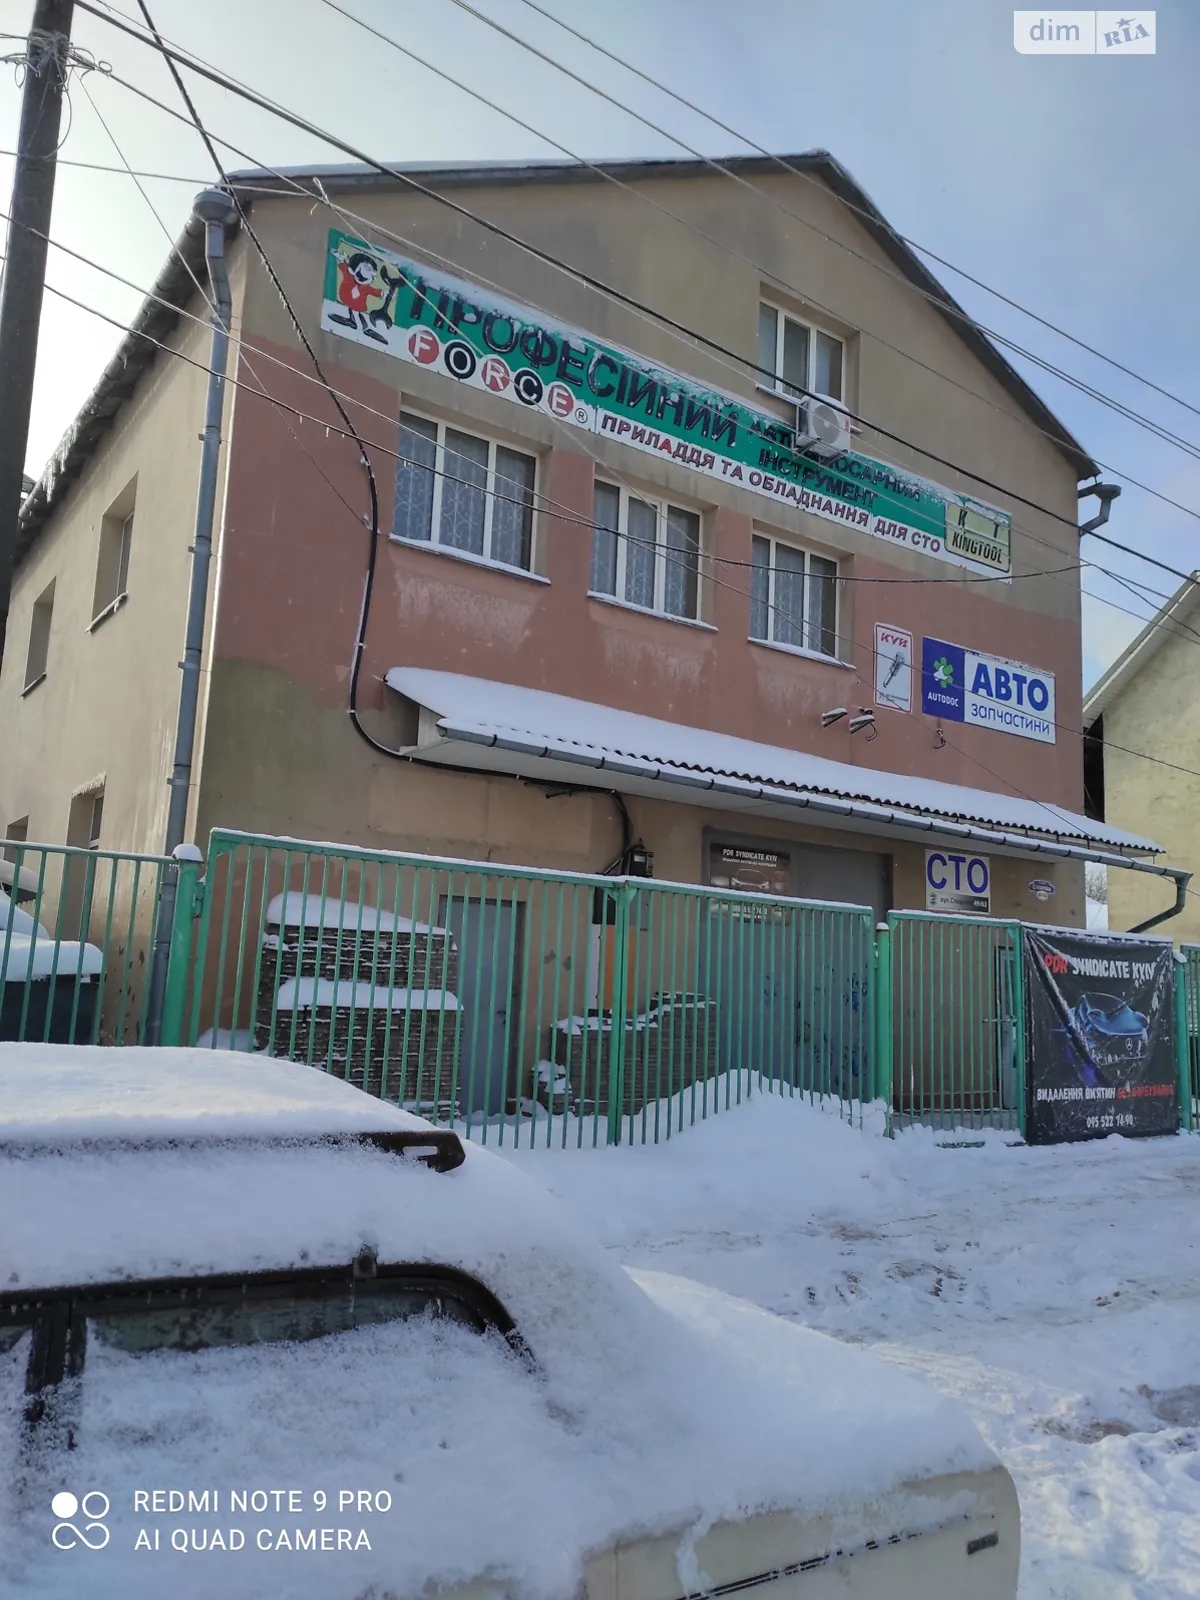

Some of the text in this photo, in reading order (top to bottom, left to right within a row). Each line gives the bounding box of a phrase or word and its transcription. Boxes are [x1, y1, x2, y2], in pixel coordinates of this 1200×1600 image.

[408, 327, 574, 417] FORCE
[601, 413, 941, 553] ПРИЛАДДЯ ТА ОБЛАДНАННЯ ДЛЯ СТО
[758, 447, 878, 507] ІНСТРУМЕНТ
[952, 531, 1003, 564] KINGTOOL
[927, 691, 959, 708] AUTODOC
[971, 662, 1049, 712] АВТО
[971, 702, 1050, 736] запчастини
[926, 853, 988, 894] СТО
[1036, 1087, 1084, 1102] ВИДАЛЕННЯ
[1100, 1115, 1114, 1127] 522
